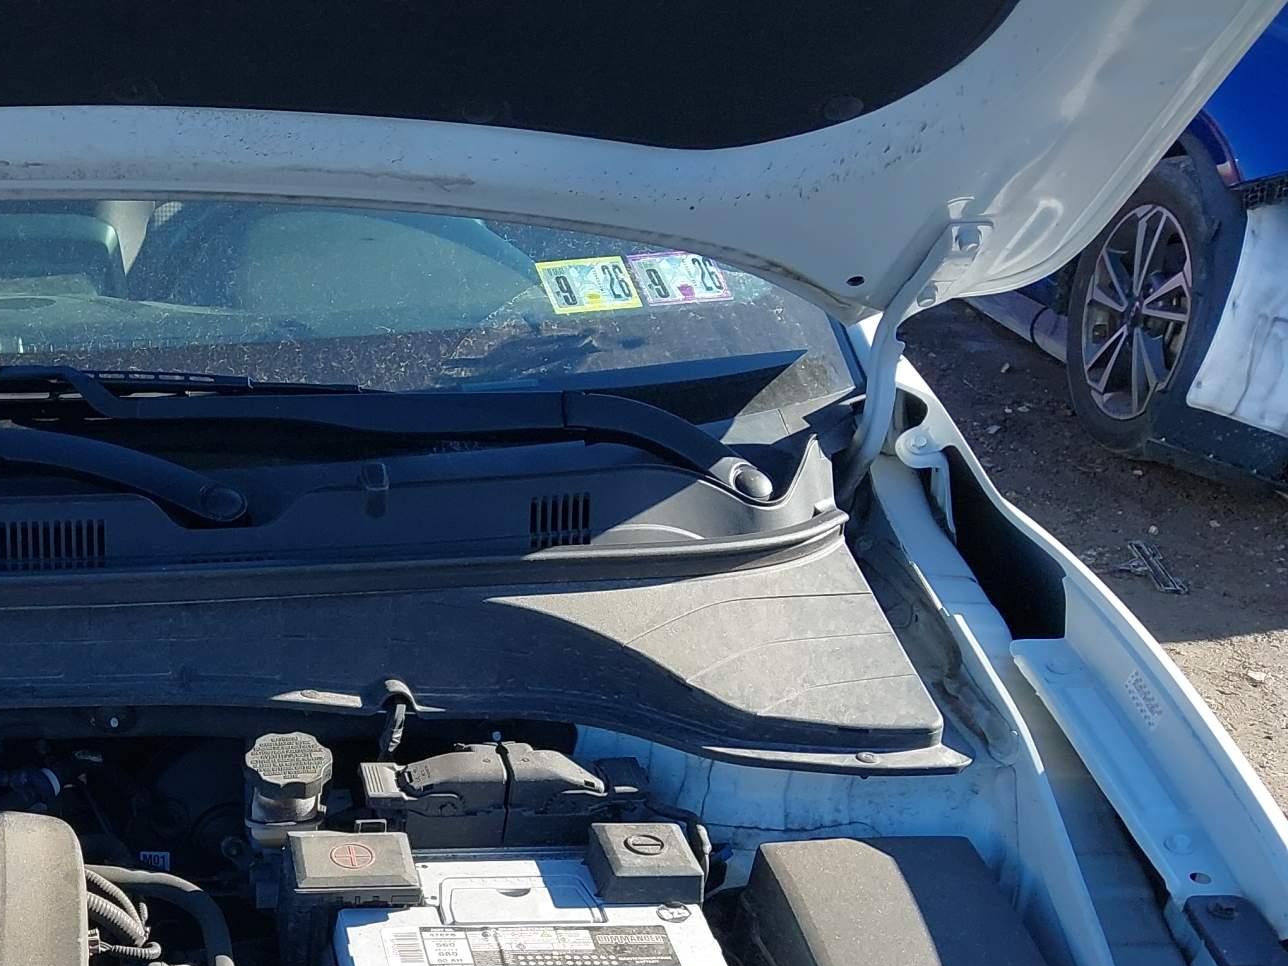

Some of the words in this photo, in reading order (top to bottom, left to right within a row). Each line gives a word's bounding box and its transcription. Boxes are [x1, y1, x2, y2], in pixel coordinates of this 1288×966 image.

[601, 264, 632, 299] 26
[691, 257, 724, 291] 26
[595, 934, 666, 945] COMMANDER
